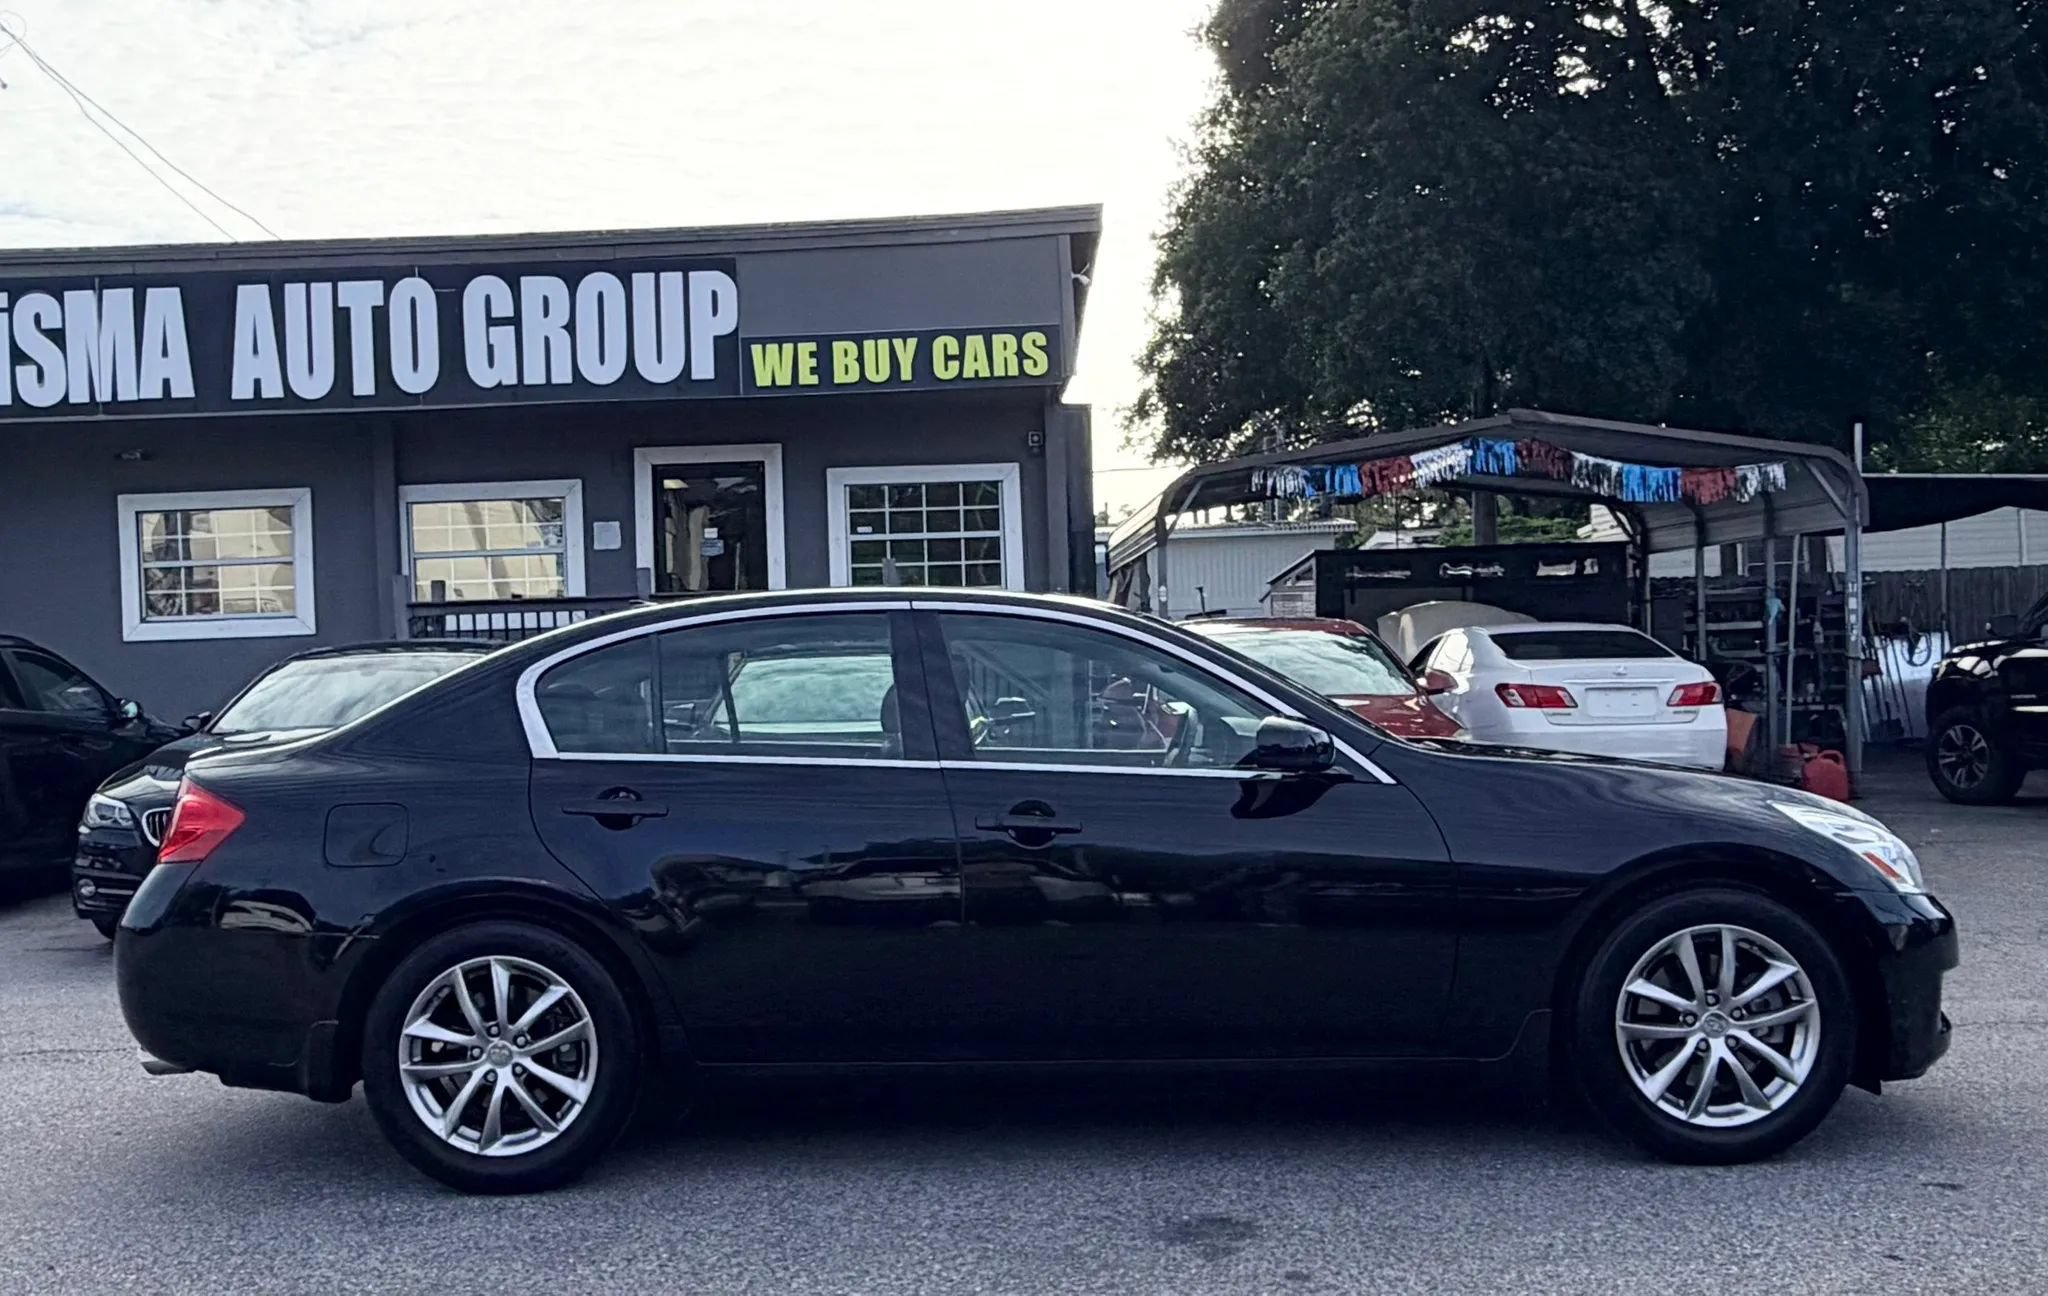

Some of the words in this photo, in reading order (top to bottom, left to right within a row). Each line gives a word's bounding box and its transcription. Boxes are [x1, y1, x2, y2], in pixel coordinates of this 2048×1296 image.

[231, 277, 440, 400] AUTO
[463, 270, 739, 388] GROUP
[751, 342, 819, 387] WE
[832, 337, 918, 384] BUY
[932, 331, 1049, 380] CARS
